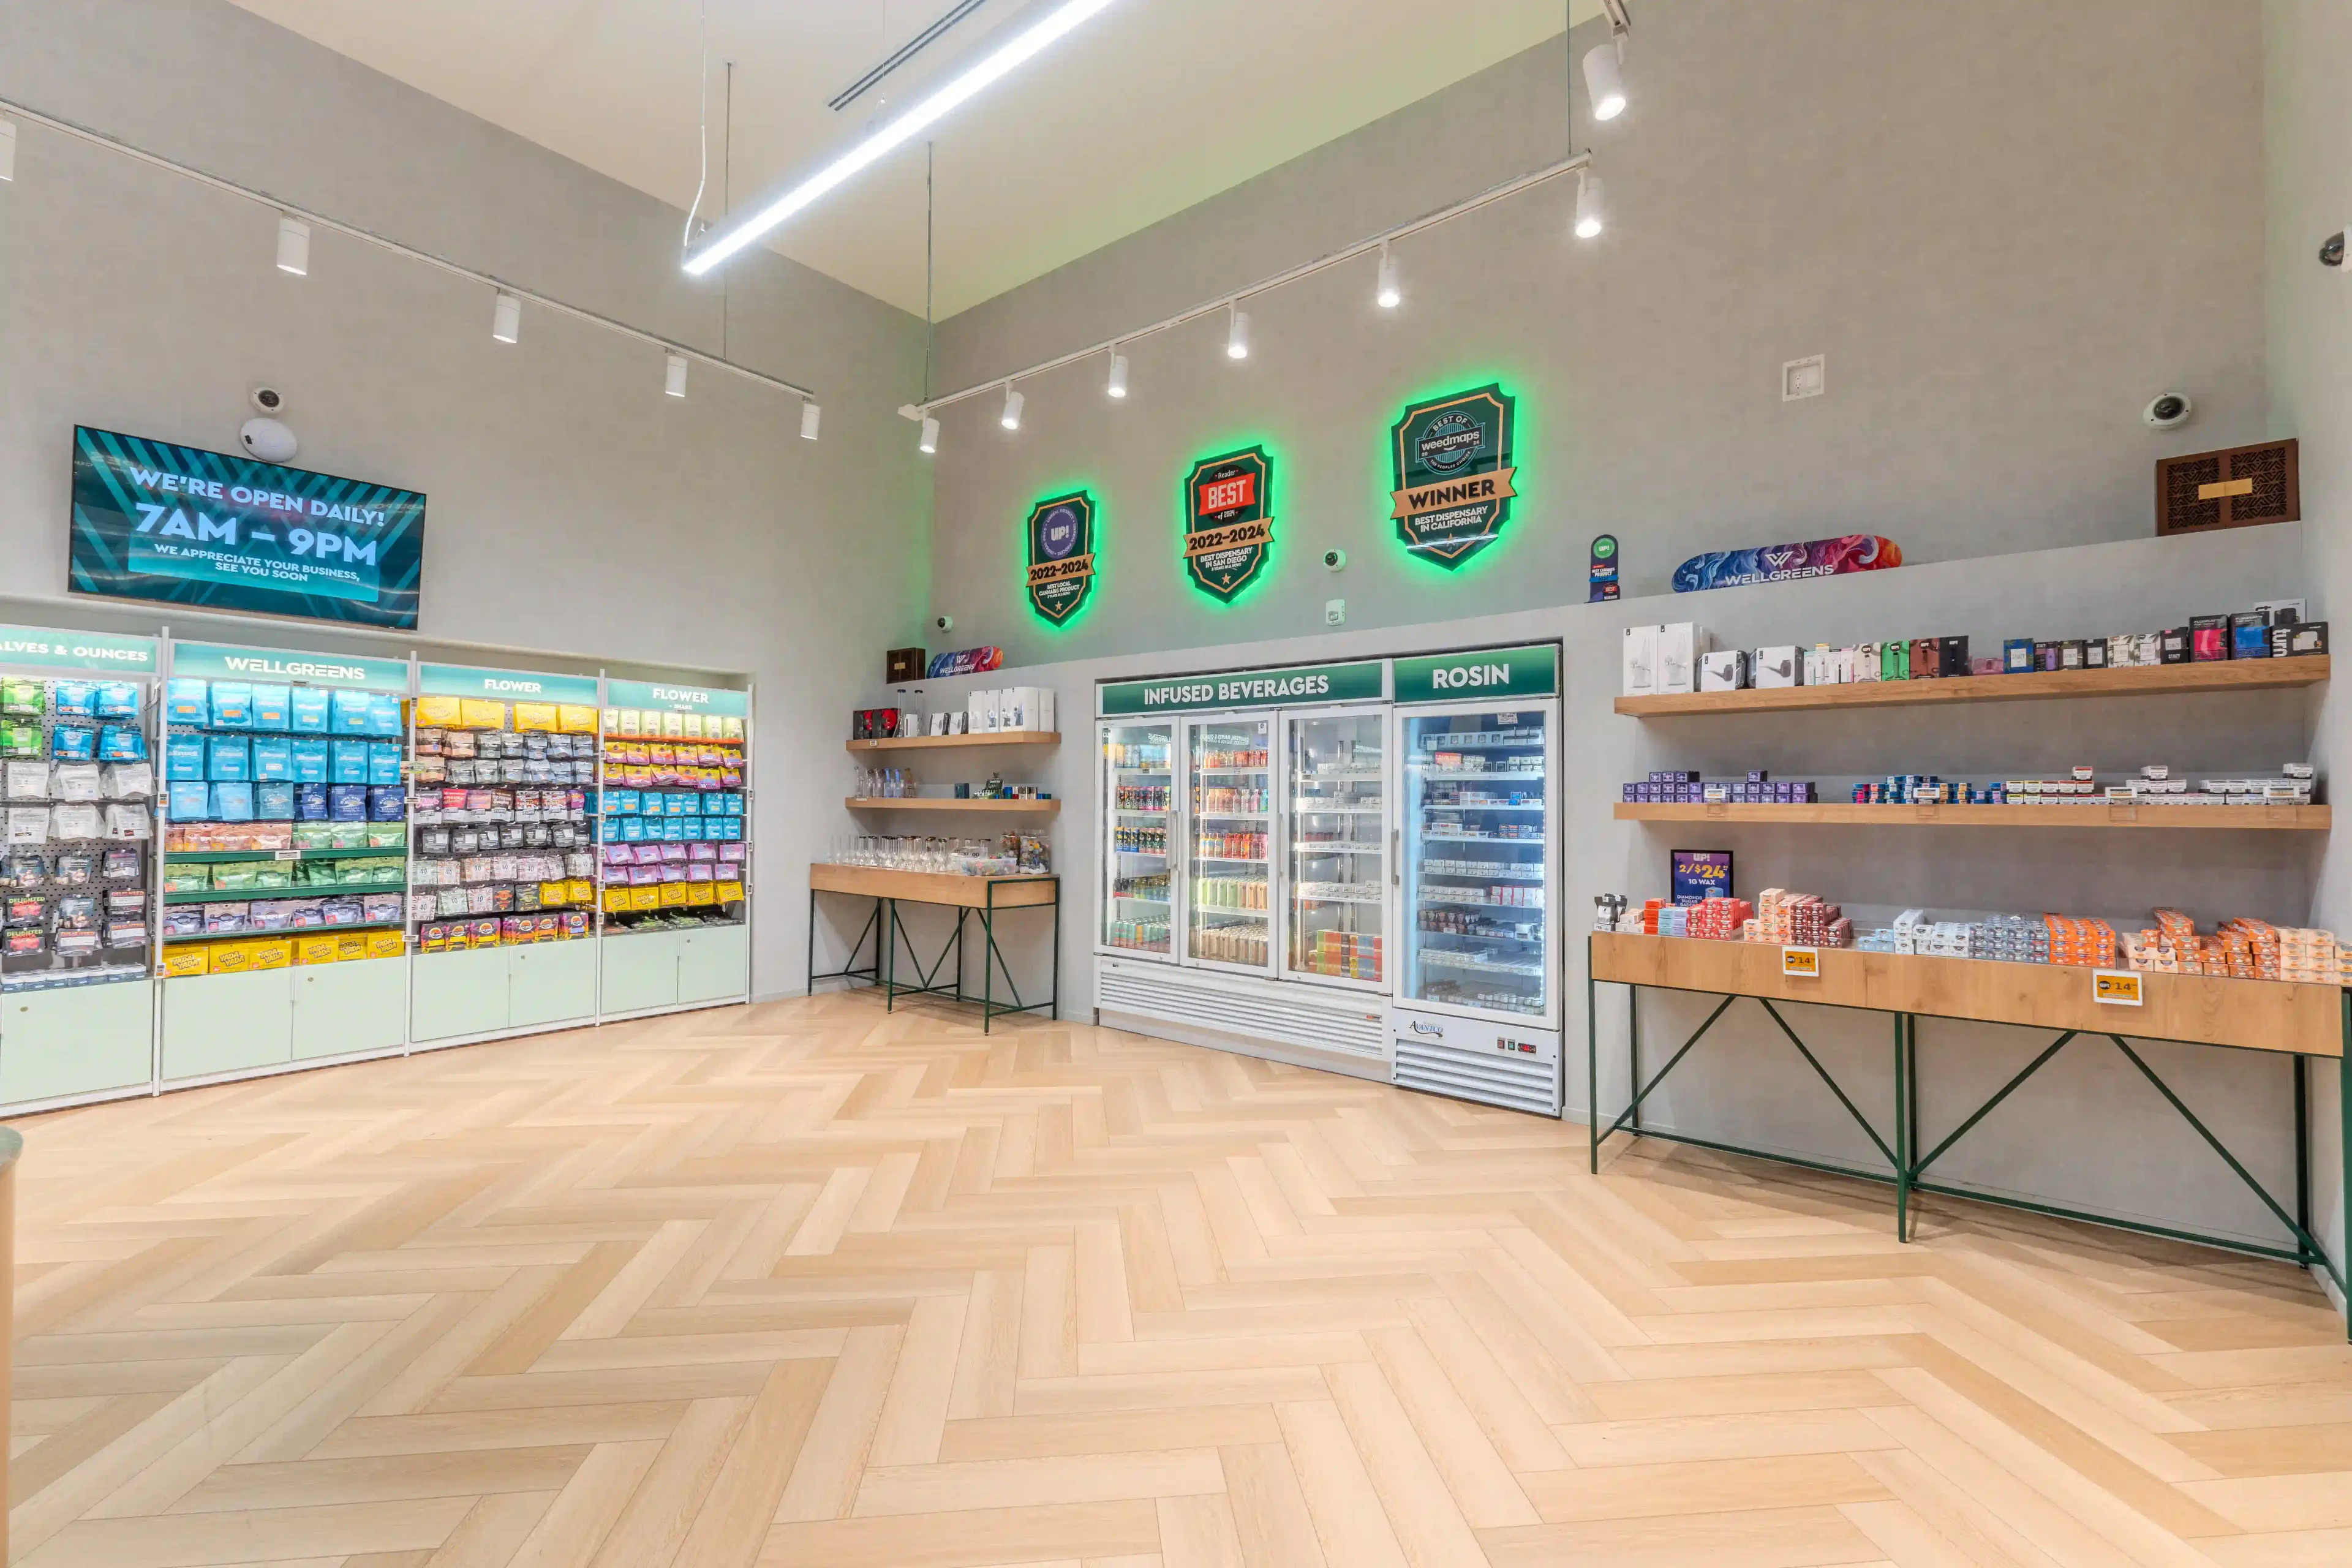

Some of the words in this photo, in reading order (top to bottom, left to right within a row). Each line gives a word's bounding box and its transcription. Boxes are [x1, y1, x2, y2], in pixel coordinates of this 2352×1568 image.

[1433, 415, 1453, 431] BEST
[1455, 415, 1468, 424] OF
[1421, 431, 1480, 451] weedmaps
[1218, 470, 1236, 479] Reader
[129, 466, 223, 500] WE'RE
[230, 486, 302, 513] OPEN
[311, 500, 385, 527] DAILY!
[1208, 480, 1246, 509] BEST
[1408, 479, 1496, 510] WINNER
[1415, 514, 1436, 526] BEST
[1436, 506, 1488, 521] DISPENSARY
[1420, 523, 1430, 532] IN
[1431, 514, 1482, 530] CALIFORNIA
[135, 502, 236, 545] 7AM
[289, 529, 377, 566] 9PM
[1050, 526, 1069, 541] UP!
[1200, 553, 1216, 562] BEST
[1215, 546, 1253, 560] DISPENSARY
[1227, 555, 1247, 564] DIEGO
[154, 543, 178, 556] WE
[181, 548, 261, 567] APPRECIATE
[264, 559, 300, 573] YOUR
[302, 564, 360, 582] BUSINESS,
[214, 562, 239, 575] SEE
[241, 565, 271, 579] YOU
[272, 568, 308, 582] SOON
[1725, 565, 1834, 586] WELLGREENS
[2272, 628, 2291, 658] turn
[54, 645, 68, 655] &
[74, 646, 148, 662] OUNCES
[225, 656, 366, 680] WELLGREENS
[940, 664, 975, 674] WELLGREENS
[1432, 663, 1510, 689] ROSIN
[484, 678, 541, 693] FLOWER
[1144, 684, 1214, 706] INFUSED
[1218, 675, 1329, 700] BEVERAGES
[652, 687, 709, 704] FLOWER
[1679, 864, 1725, 879] 2/$24
[307, 944, 326, 954] YADA
[375, 938, 393, 948] YADA
[380, 942, 398, 953] YADA
[172, 955, 193, 965] YADA
[219, 951, 240, 962] YADA
[225, 955, 245, 967] YADA
[259, 948, 277, 959] YADA
[265, 952, 284, 963] YADA
[314, 947, 331, 959] YADA
[178, 959, 199, 970] YADA
[1409, 1020, 1444, 1034] AVANTCO
